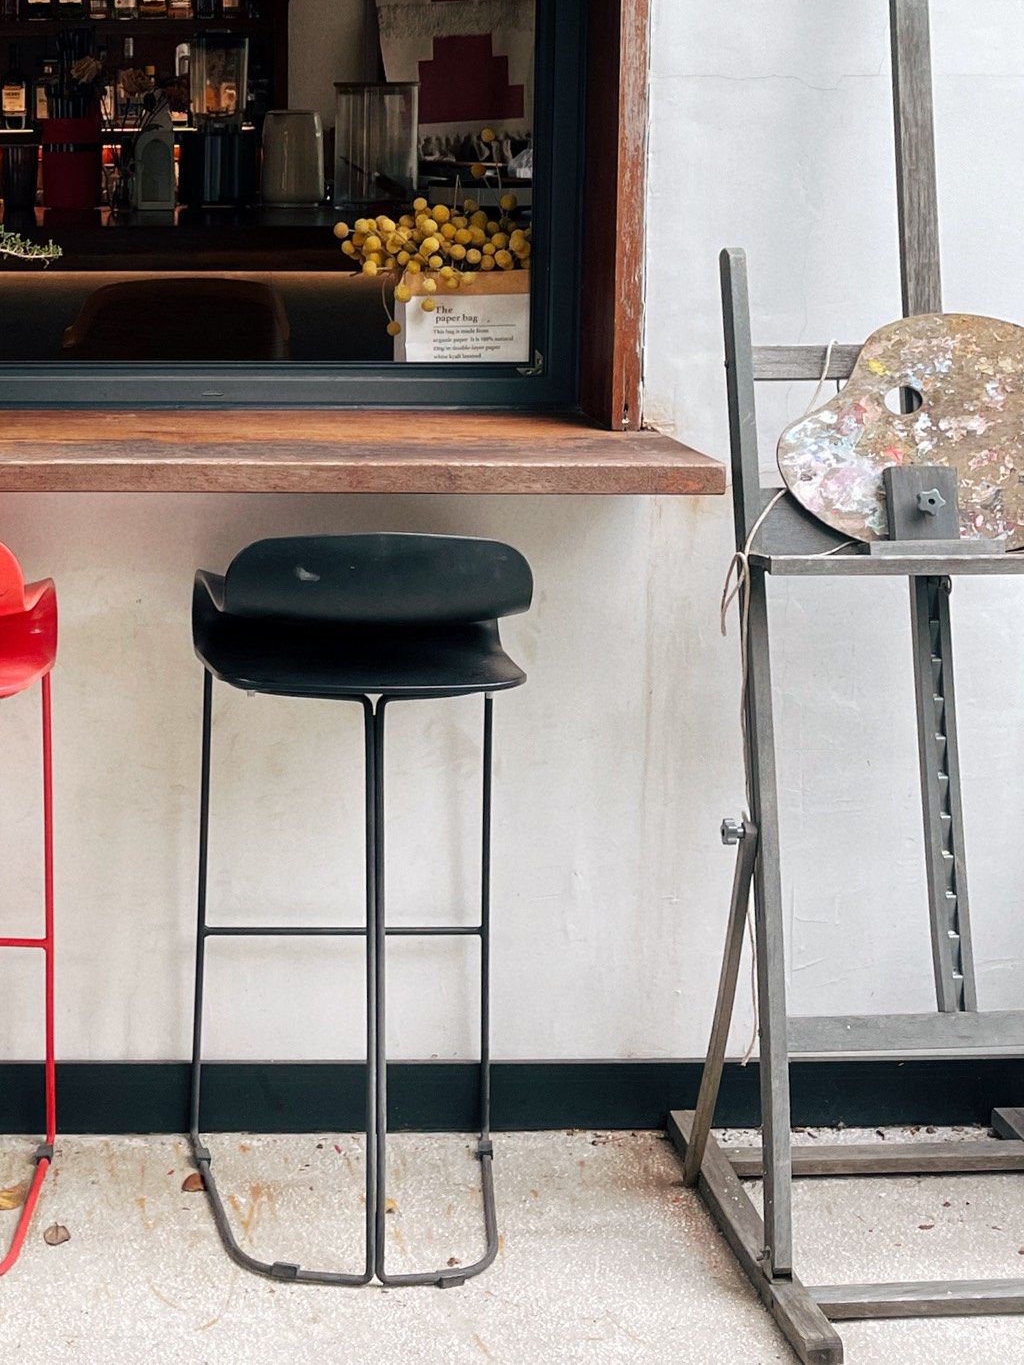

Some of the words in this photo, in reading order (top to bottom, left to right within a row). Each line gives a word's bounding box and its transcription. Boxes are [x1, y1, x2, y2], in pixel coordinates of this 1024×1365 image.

[436, 305, 453, 314] The
[435, 315, 460, 324] paper
[462, 314, 478, 323] bag
